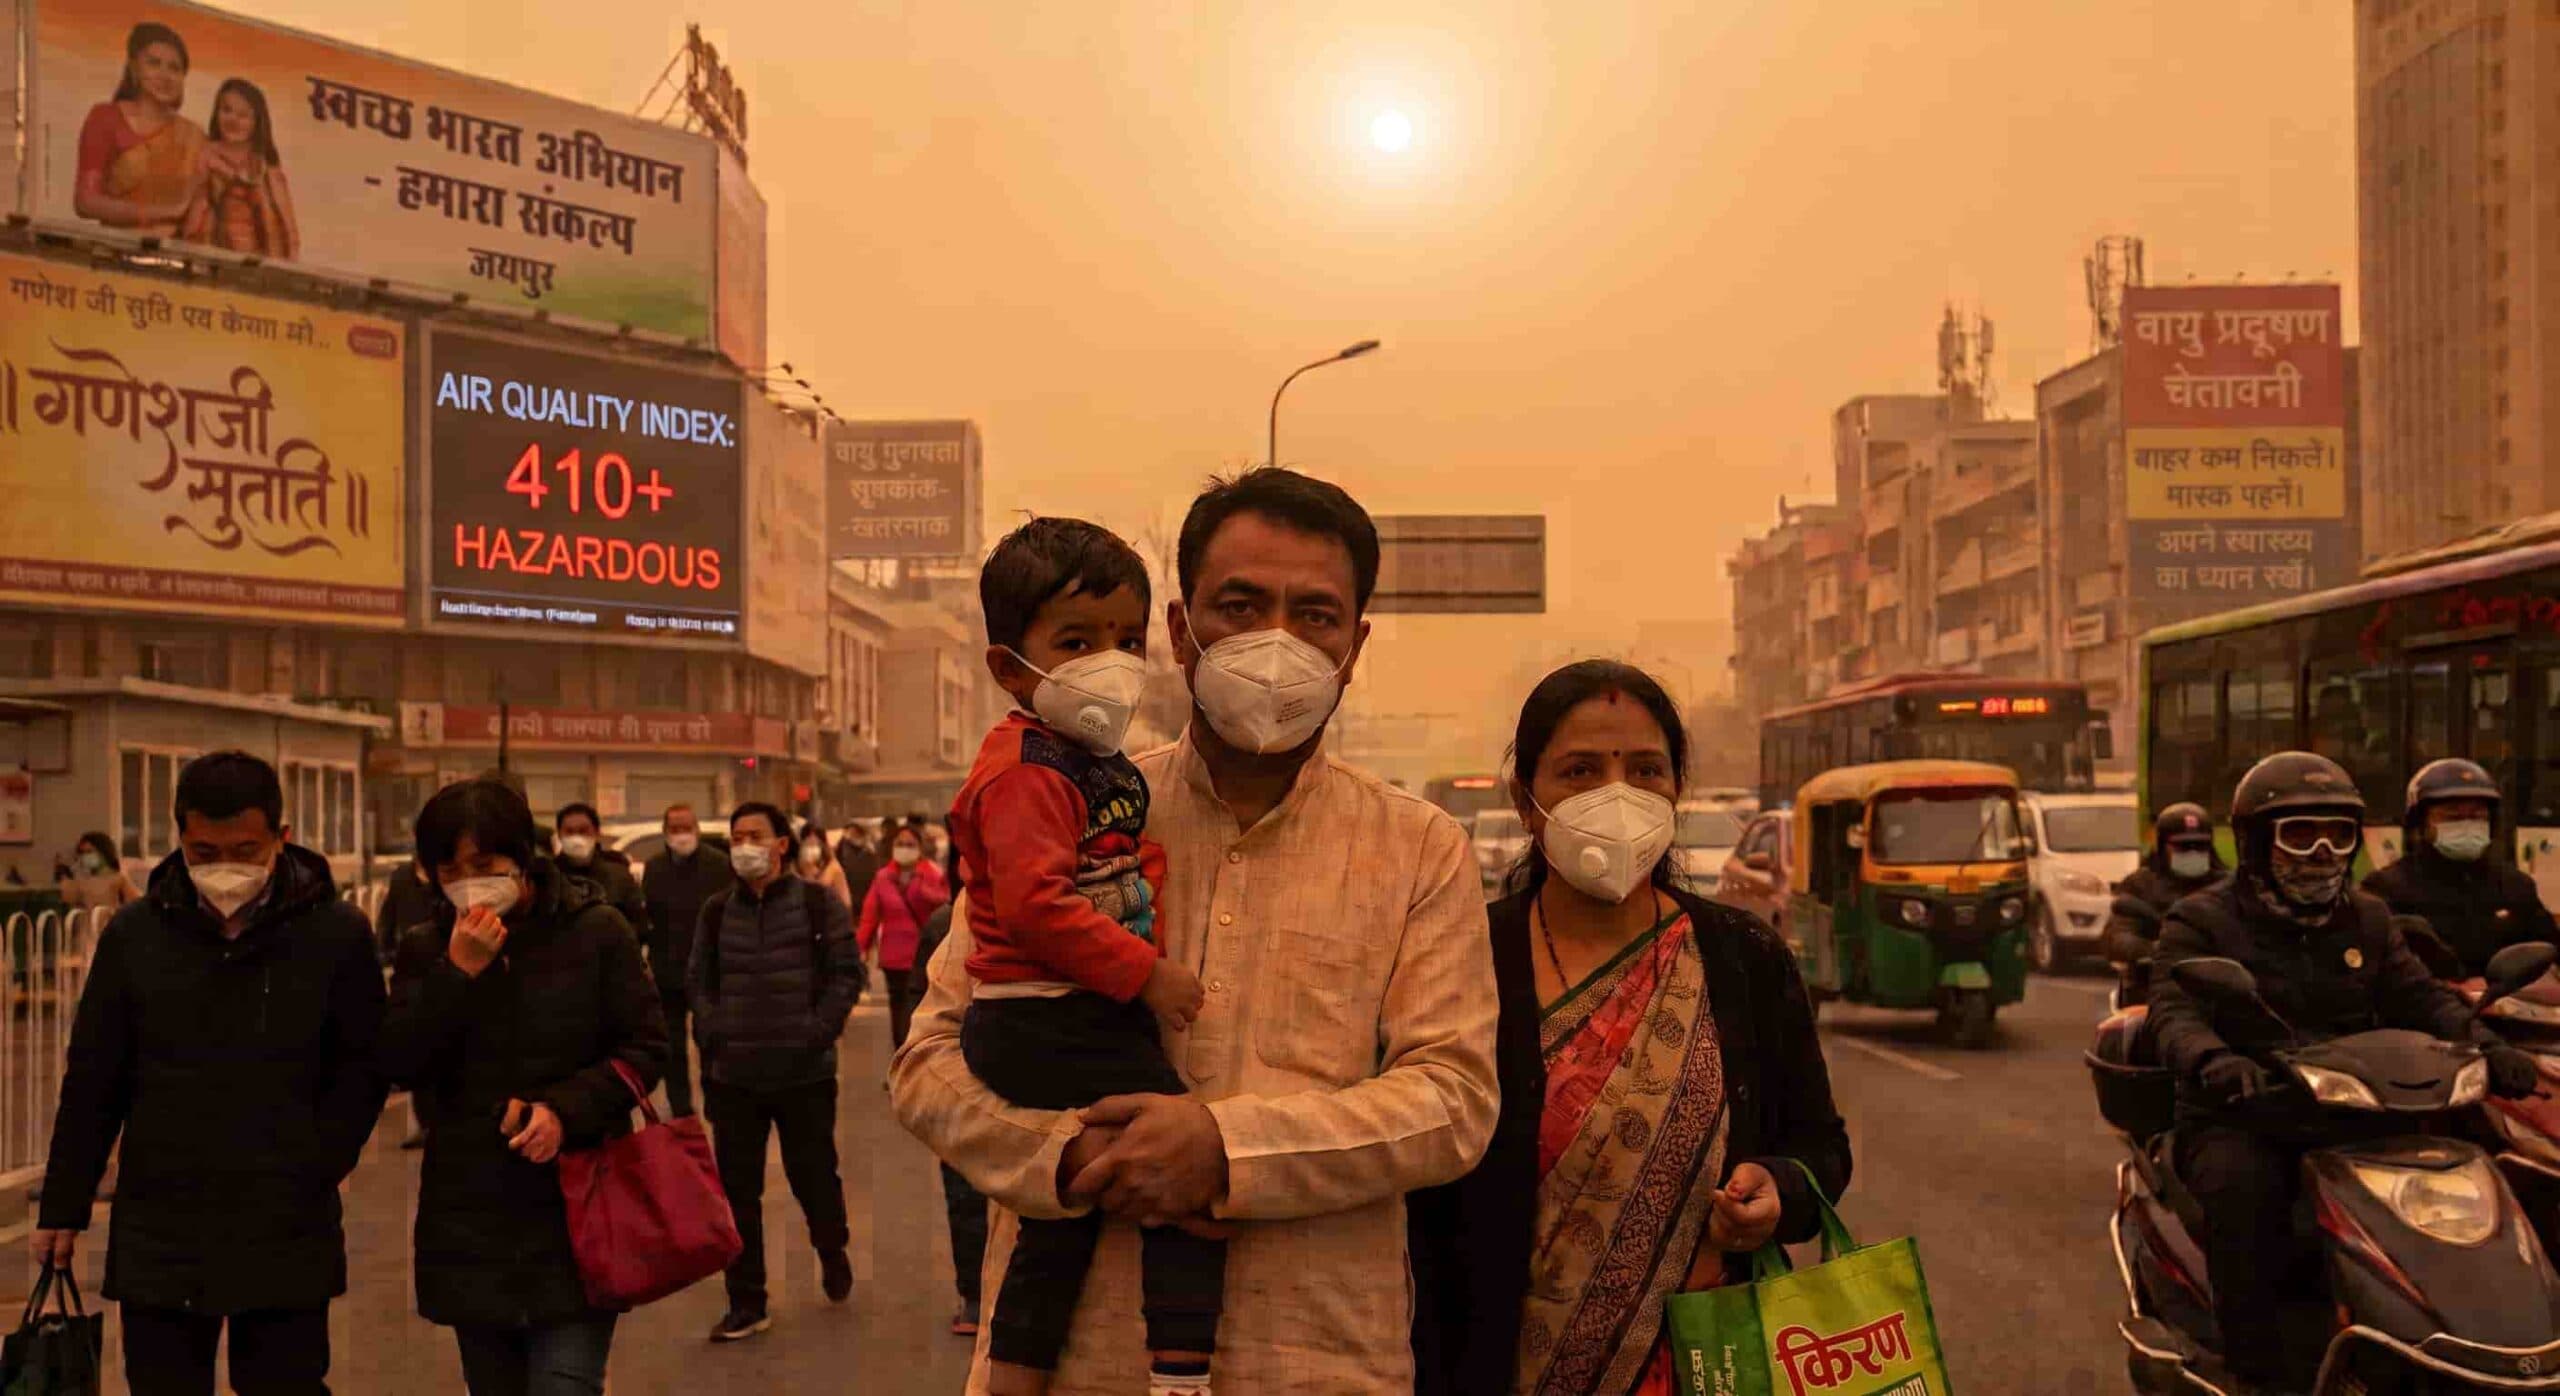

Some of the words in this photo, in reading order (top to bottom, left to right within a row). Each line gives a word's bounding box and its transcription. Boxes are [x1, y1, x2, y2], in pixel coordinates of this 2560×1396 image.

[306, 75, 413, 139] स्वच्छ
[425, 106, 522, 166] भारत
[535, 130, 684, 203] अभियान
[396, 166, 505, 228] हमारा
[516, 184, 636, 255] संकल्प
[467, 248, 556, 299] जयपुर
[2134, 310, 2205, 358] वायु
[2215, 308, 2329, 358] प्रदूषण
[437, 372, 494, 414] AIR
[501, 381, 634, 432] QUALITY
[641, 402, 736, 447] INDEX:
[2163, 361, 2302, 409] चेतावनी
[506, 443, 674, 519] 410+
[2200, 447, 2241, 470] कम
[455, 523, 721, 590] HAZARDOUS
[1774, 1310, 1914, 1396] किरण
